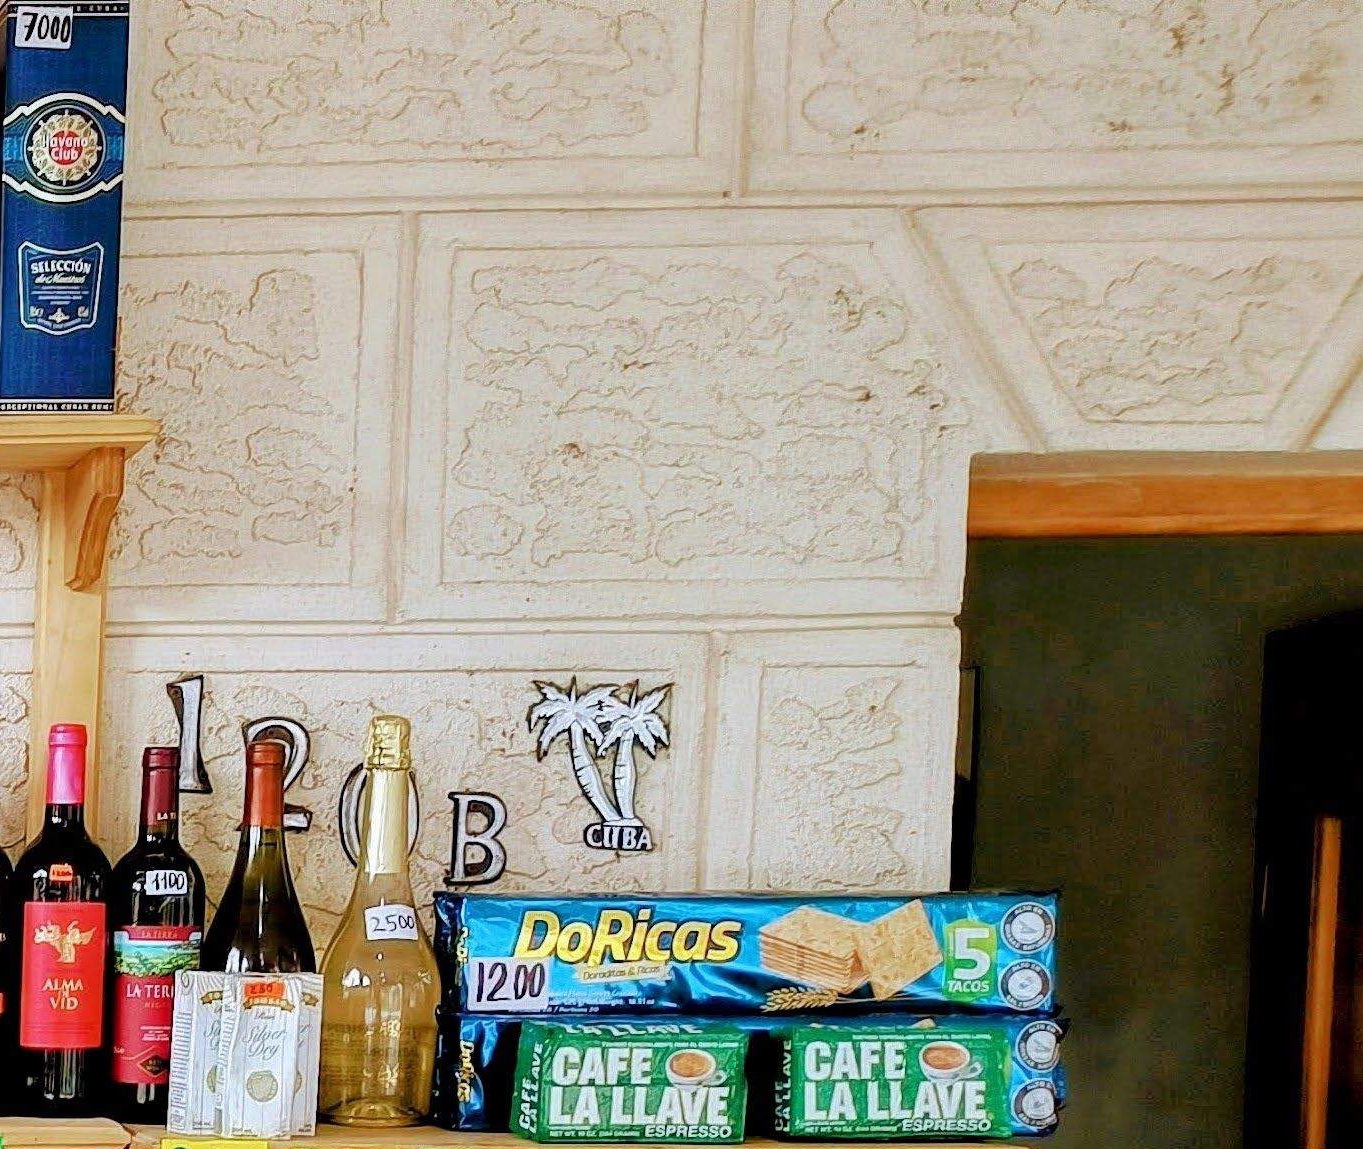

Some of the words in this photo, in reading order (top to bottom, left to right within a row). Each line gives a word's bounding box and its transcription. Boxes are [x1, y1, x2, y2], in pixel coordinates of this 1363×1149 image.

[22, 16, 71, 43] 7000
[50, 147, 79, 161] Club
[152, 873, 185, 891] 1100
[372, 915, 415, 931] 2500
[514, 907, 742, 968] DoRicas
[950, 927, 991, 980] 5
[43, 978, 83, 991] ALMA
[947, 980, 989, 993] TACOS
[49, 997, 78, 1010] VID
[552, 1047, 637, 1086] CAFE
[804, 1041, 905, 1083] CAFE
[551, 1089, 599, 1125] LA
[603, 1086, 730, 1125] LLAVE
[644, 1125, 732, 1139] ESPRESSO
[901, 1118, 991, 1132] ESPRESSO
